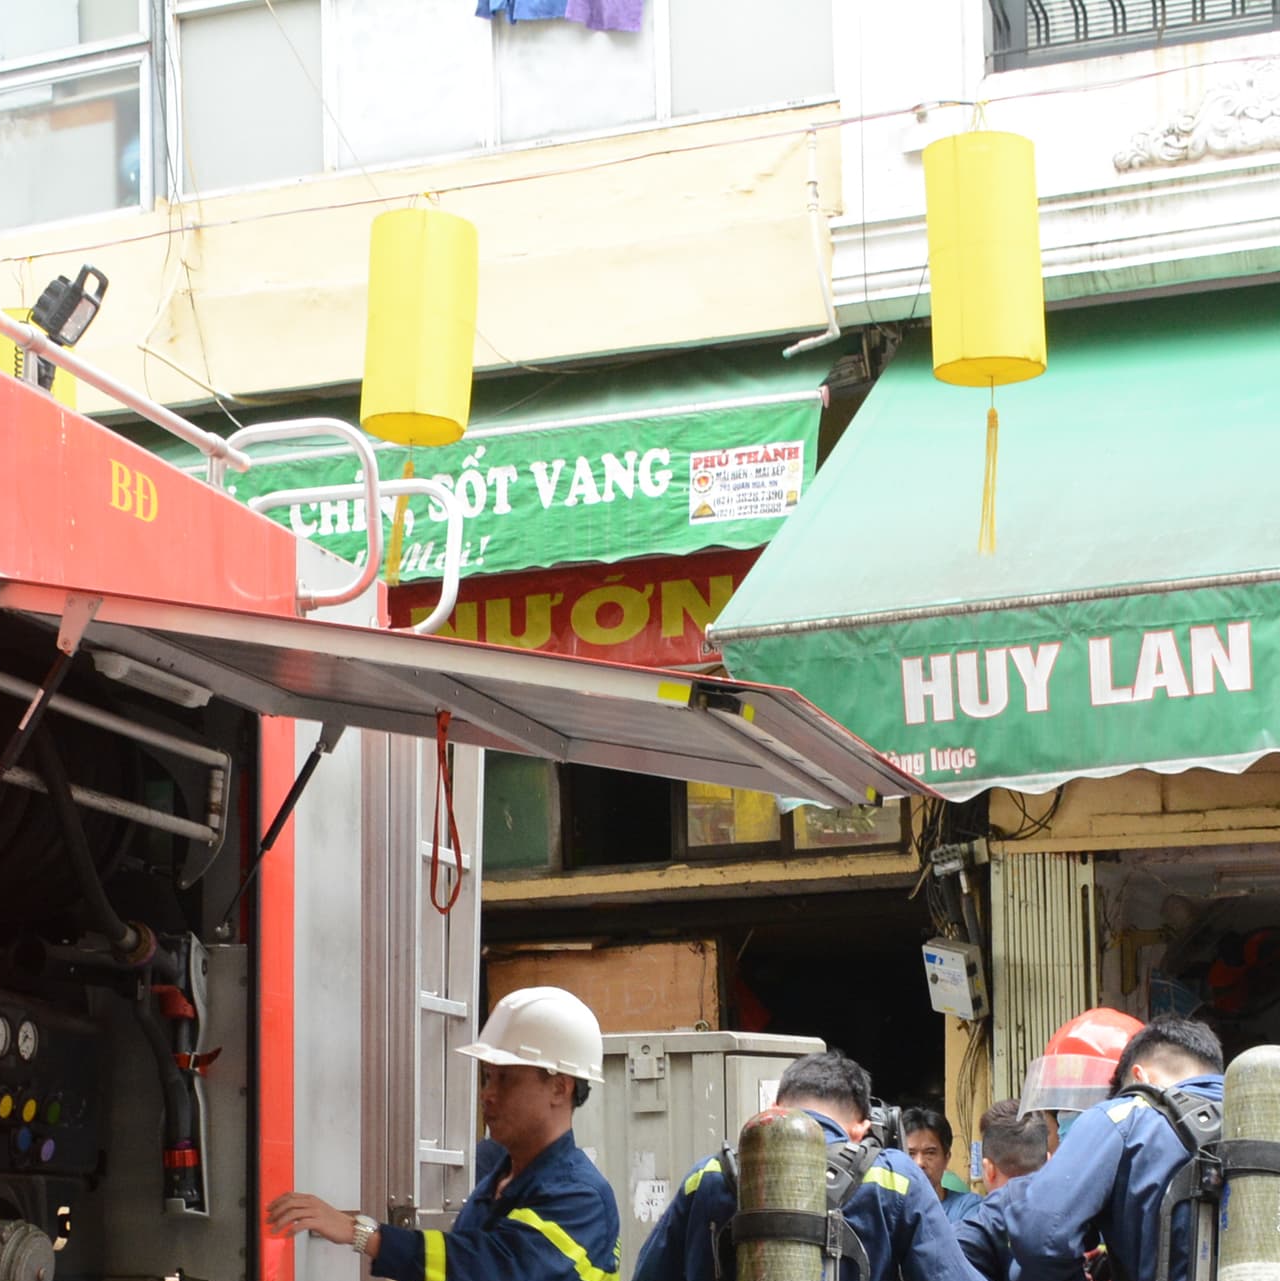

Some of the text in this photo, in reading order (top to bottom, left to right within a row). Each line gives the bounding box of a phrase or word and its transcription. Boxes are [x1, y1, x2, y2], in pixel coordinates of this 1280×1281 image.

[530, 447, 674, 508] VANG
[692, 445, 800, 470] PHÚ THÀNH
[109, 458, 158, 523] BĐ
[901, 641, 1061, 725] HUY
[1088, 621, 1253, 706] LAN
[930, 747, 977, 775] lược
